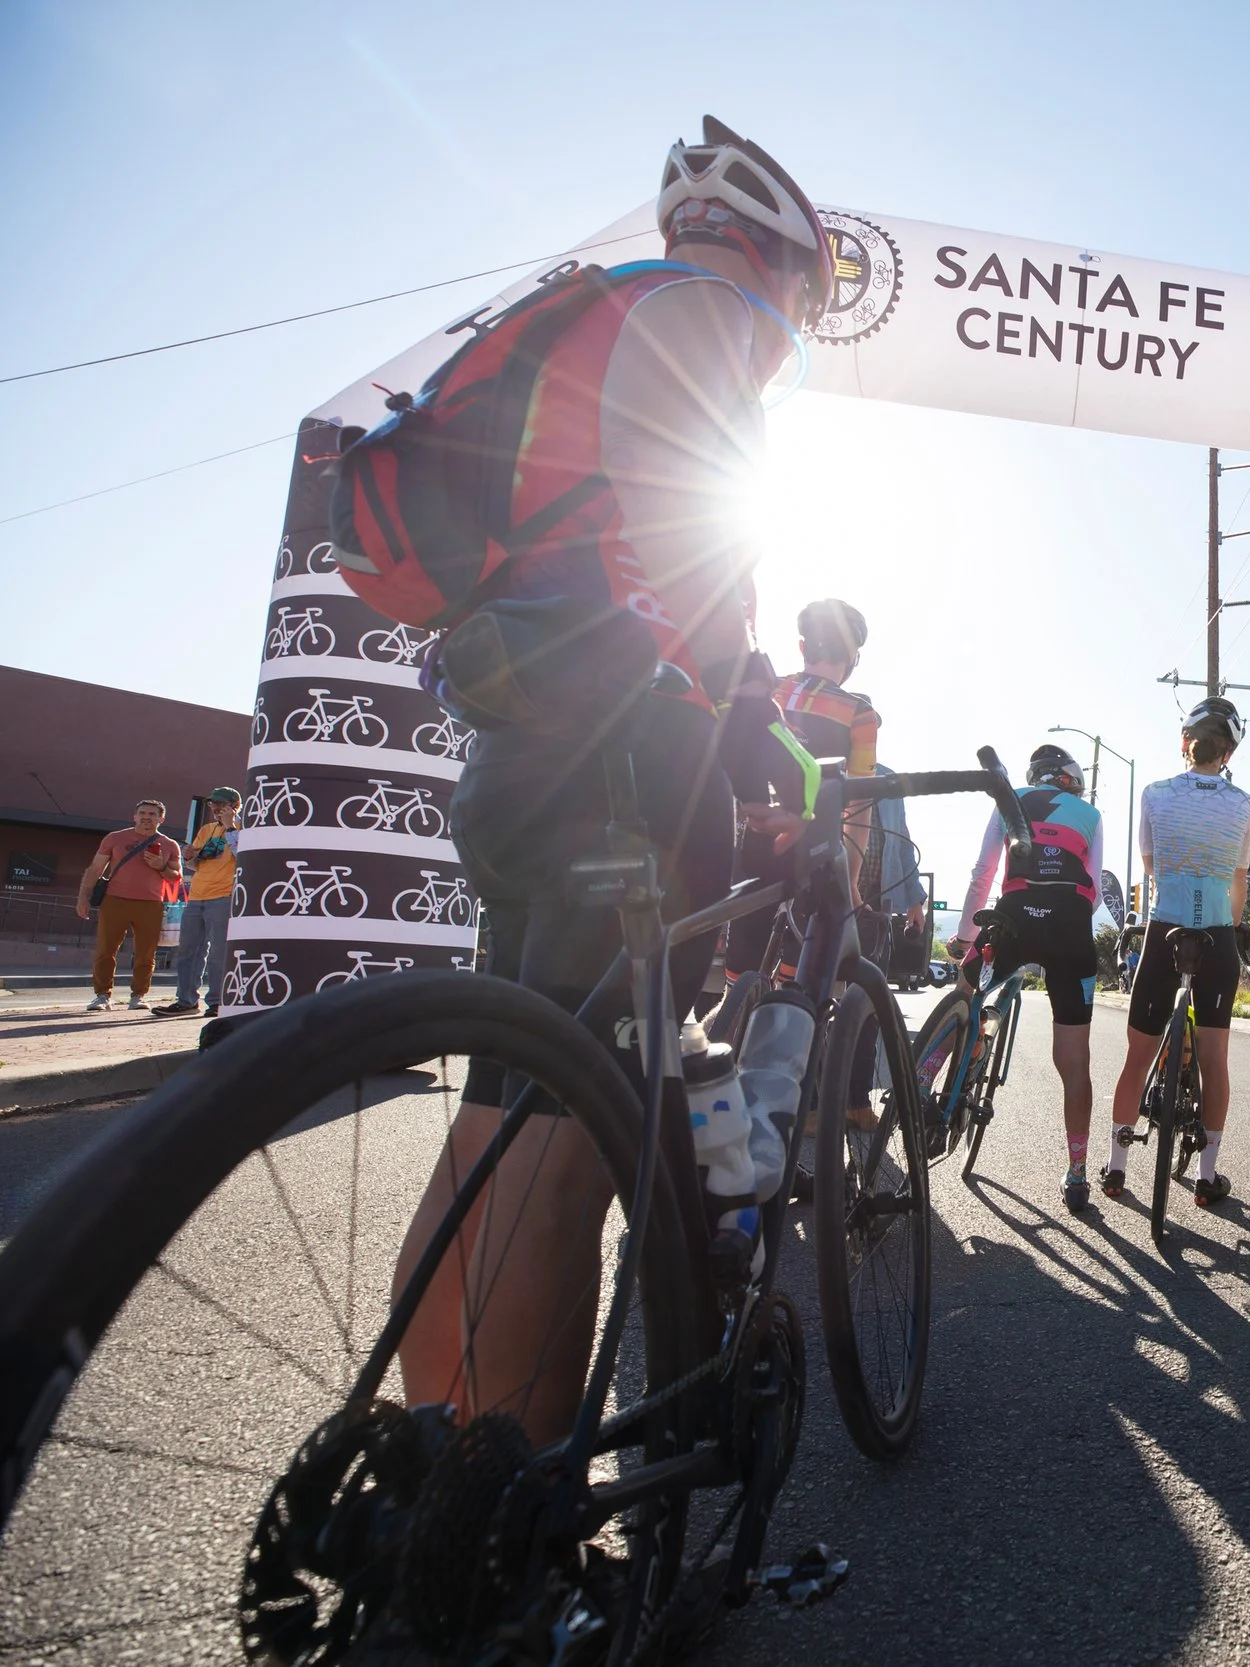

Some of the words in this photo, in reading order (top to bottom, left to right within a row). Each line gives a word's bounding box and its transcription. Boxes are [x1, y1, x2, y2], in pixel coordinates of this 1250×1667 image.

[934, 245, 1140, 319] SANTA
[1158, 281, 1226, 331] FE
[955, 306, 1200, 380] CENTURY
[13, 867, 30, 876] TAI
[1023, 904, 1052, 915] MELLOW
[1028, 910, 1045, 918] VELO
